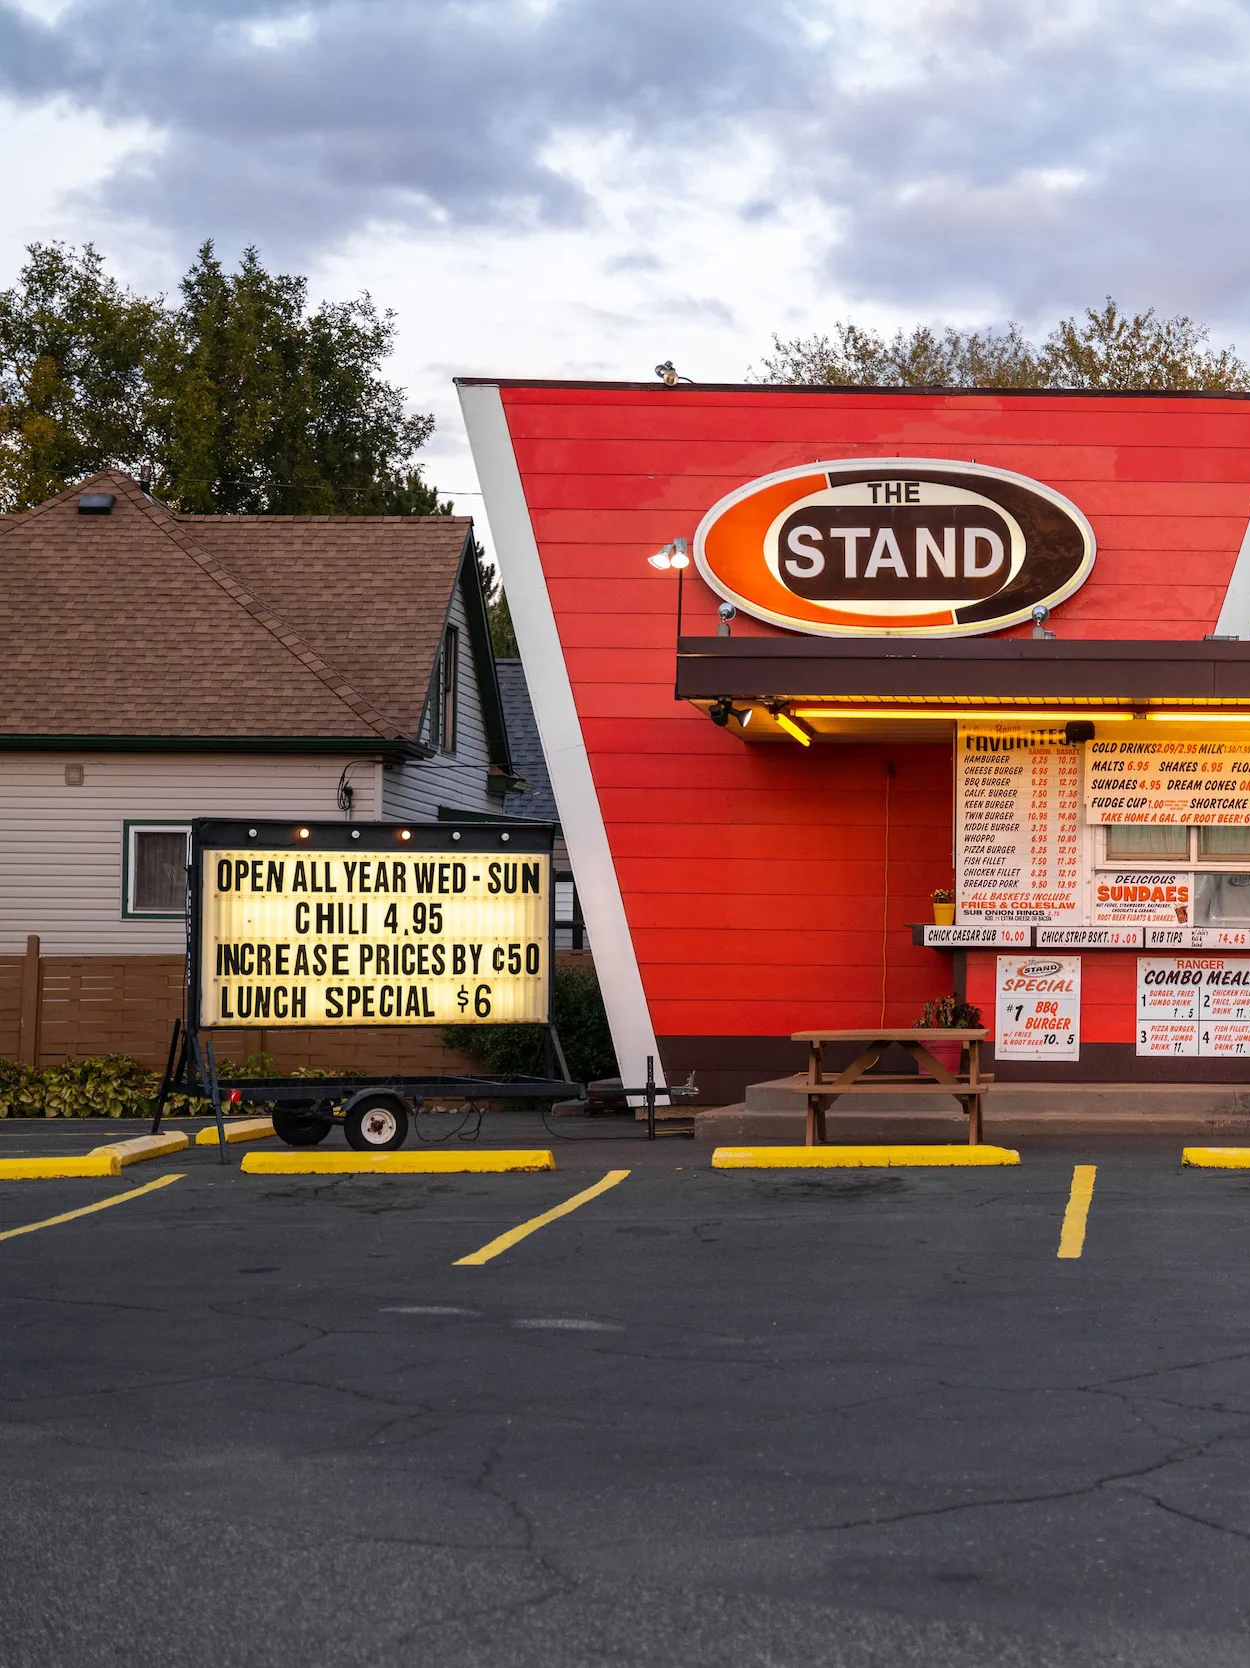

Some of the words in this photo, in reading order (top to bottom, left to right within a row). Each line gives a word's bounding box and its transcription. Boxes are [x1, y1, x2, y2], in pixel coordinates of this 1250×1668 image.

[868, 483, 920, 503] THE
[785, 526, 1004, 578] STAND
[1092, 762, 1124, 771] MALTS
[1128, 762, 1149, 771] 6.95
[1159, 762, 1198, 772] SHAKES
[1201, 763, 1223, 772] 6.95
[1091, 780, 1137, 790] SUNDAES
[1139, 780, 1161, 790] 4.95
[218, 859, 284, 893] OPEN
[293, 861, 336, 892] ALL
[344, 862, 406, 892] YEAR
[1115, 875, 1176, 884] DELICIOUS
[1097, 886, 1188, 902] SUNDAES
[296, 902, 368, 934] CHILI
[384, 902, 442, 935] 4.95
[928, 930, 951, 941] CHICK
[953, 930, 979, 941] CAESAR
[982, 930, 997, 941] SUB
[1001, 931, 1024, 941] 10.00
[1041, 931, 1064, 942] CHICK
[1066, 931, 1087, 942] STRIP
[1088, 932, 1109, 943] BSKT.
[1152, 932, 1164, 942] RIB
[1166, 932, 1183, 943] TIPS
[1218, 934, 1245, 944] 14.45
[217, 944, 349, 975] INCREASE
[359, 944, 445, 975] PRICES
[453, 944, 482, 975] BY
[493, 943, 539, 974] ¢50
[1177, 960, 1224, 969] RANGER
[1024, 964, 1057, 973] STAND
[1145, 970, 1202, 985] COMBO
[1002, 979, 1073, 992] SPECIAL
[222, 986, 306, 1018] LUNCH
[326, 986, 435, 1018] SPECIAL
[458, 985, 491, 1017] $6
[1036, 1002, 1058, 1016] BBQ
[1026, 1018, 1071, 1030] BURGER
